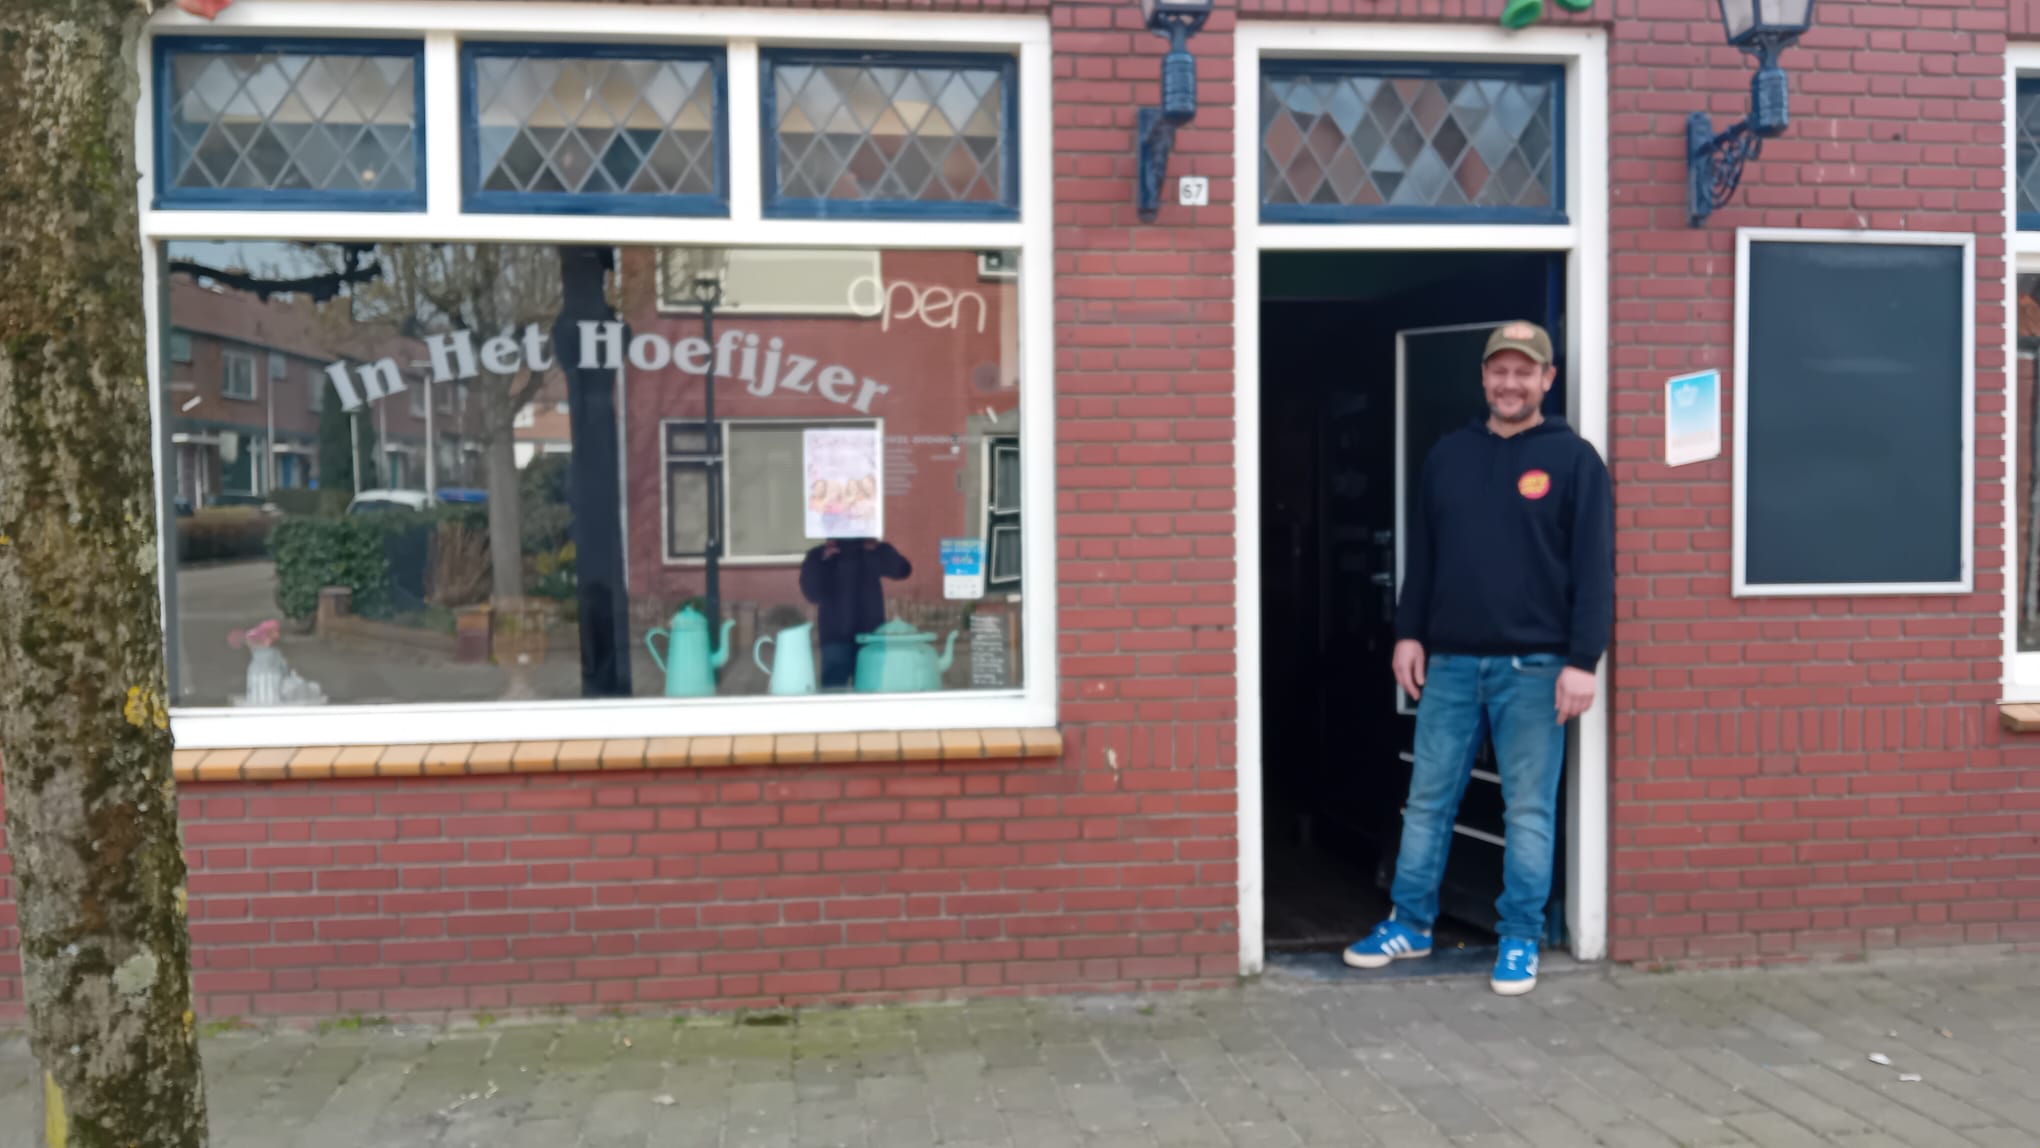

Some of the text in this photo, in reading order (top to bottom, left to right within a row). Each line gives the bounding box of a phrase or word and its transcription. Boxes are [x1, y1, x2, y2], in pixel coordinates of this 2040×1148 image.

[1182, 183, 1203, 199] 67
[324, 319, 889, 414] In Het Hoefijzer
